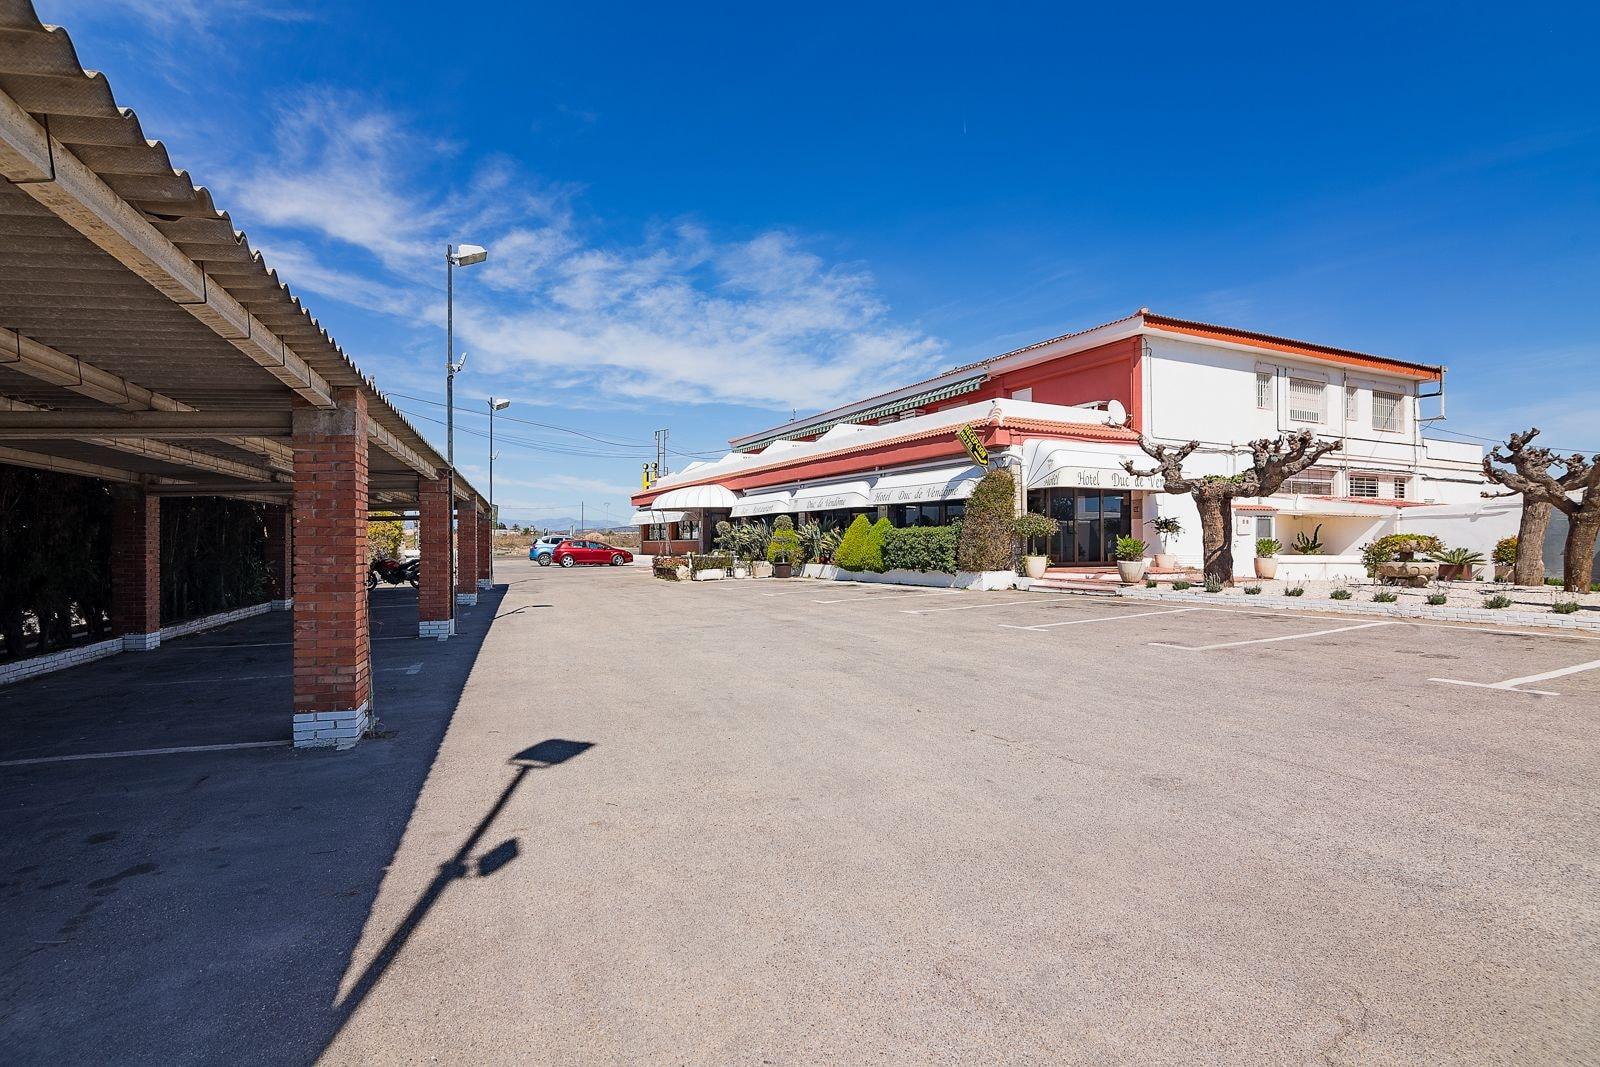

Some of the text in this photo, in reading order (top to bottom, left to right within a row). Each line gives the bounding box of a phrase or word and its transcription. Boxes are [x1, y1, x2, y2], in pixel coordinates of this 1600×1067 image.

[960, 430, 973, 451] HOTEL
[1077, 470, 1100, 487] Hotel
[1112, 472, 1130, 487] Duc
[1134, 474, 1144, 487] de
[873, 490, 894, 502] Hotel
[899, 490, 912, 500] Duc
[914, 488, 923, 499] de
